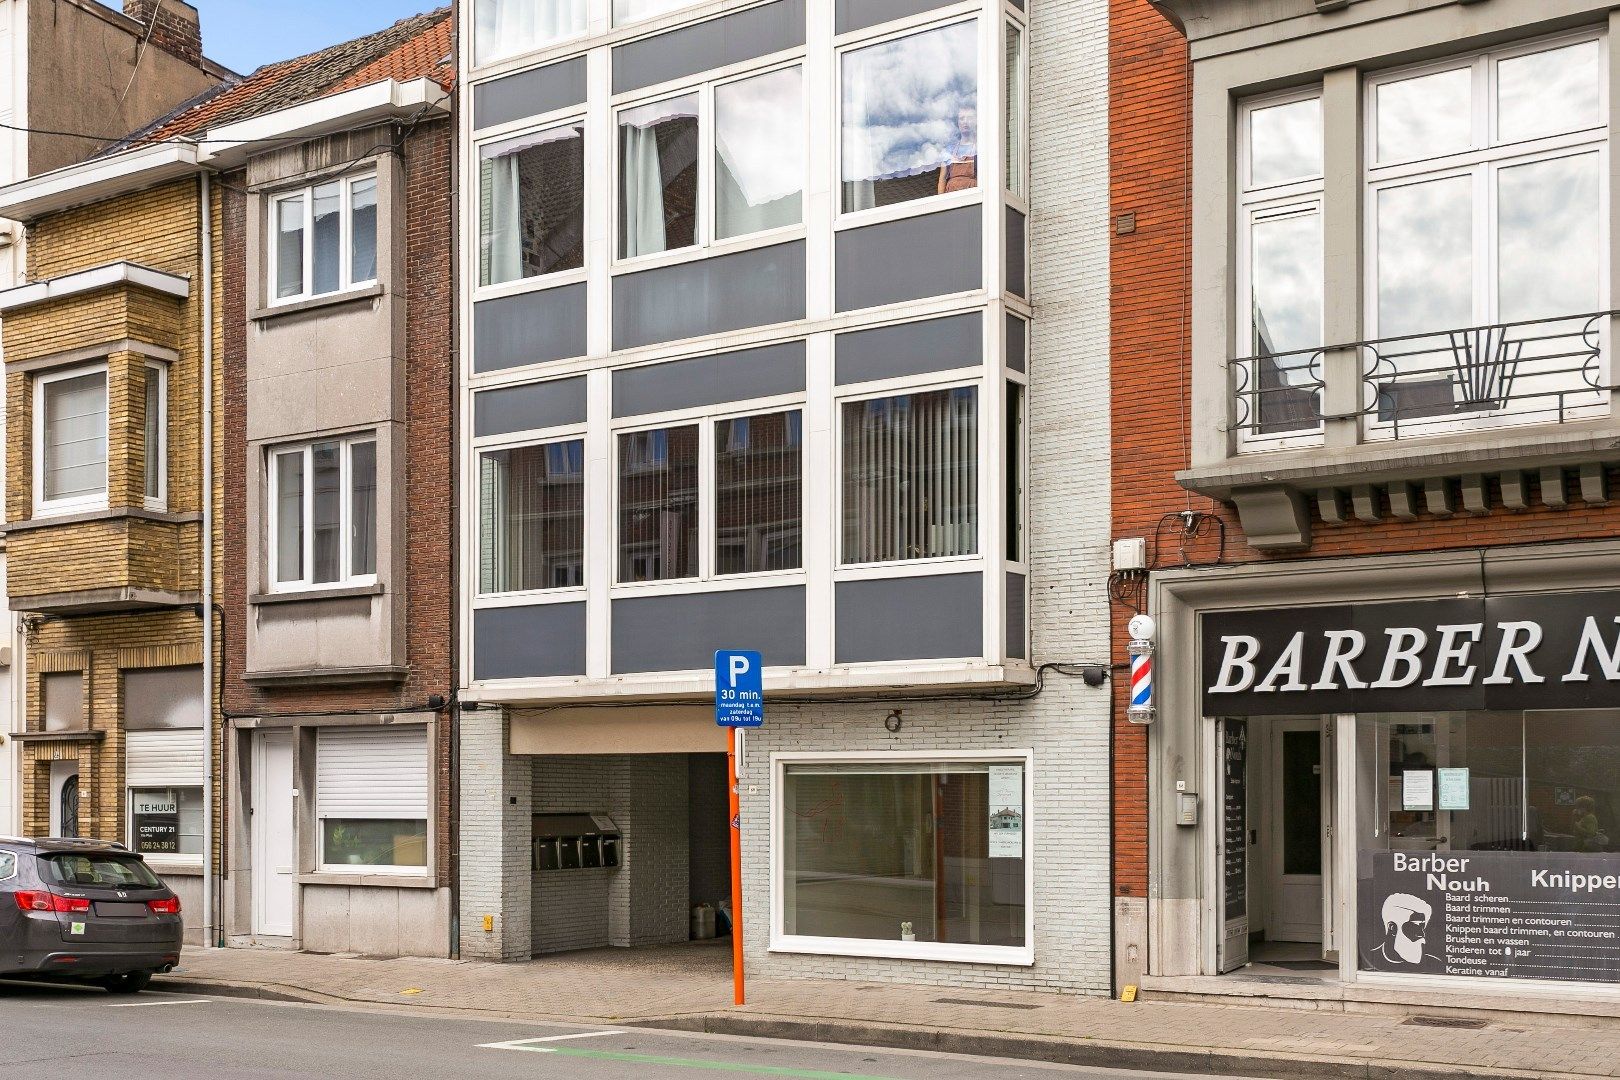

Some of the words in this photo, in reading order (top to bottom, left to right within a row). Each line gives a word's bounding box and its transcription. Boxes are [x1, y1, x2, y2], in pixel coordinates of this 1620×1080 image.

[1208, 620, 1546, 693] BARBER
[729, 655, 750, 688] P
[721, 689, 735, 700] 30
[740, 689, 761, 700] min.
[1393, 852, 1470, 873] Barber
[1426, 873, 1490, 892] Nouh
[1531, 869, 1620, 893] Knippe
[1445, 892, 1471, 902] Baard
[1474, 893, 1509, 903] scheren
[1445, 903, 1471, 912] Baard
[1472, 904, 1511, 914] trimmen
[1445, 913, 1471, 923] Baard
[1472, 915, 1510, 924] trimmen
[1524, 918, 1572, 926] contouren
[1445, 923, 1481, 935] Knippen
[1483, 925, 1508, 935] baard
[1509, 926, 1552, 938] trimmen,
[1553, 929, 1565, 937] en
[1566, 929, 1615, 939] contouren
[1445, 934, 1482, 944] Brushen
[1483, 937, 1495, 945] en
[1445, 945, 1485, 954] Kinderen
[1488, 948, 1502, 956] tot
[1514, 948, 1532, 959] jaar
[1445, 954, 1488, 965] Tondeuse
[1445, 965, 1483, 975] Keratine
[1484, 967, 1509, 977] vanaf
